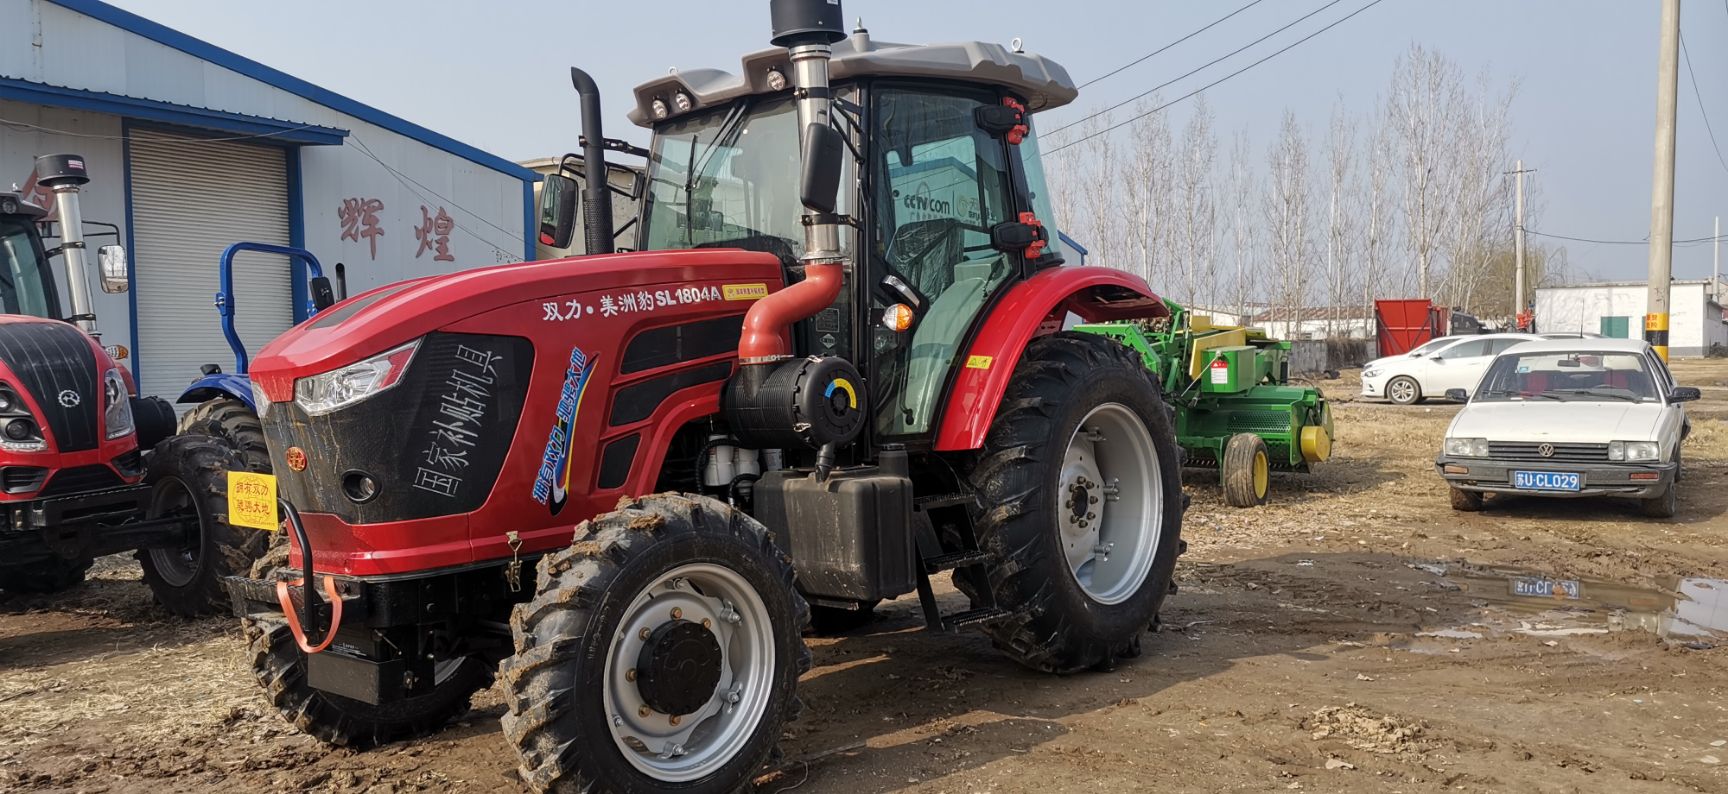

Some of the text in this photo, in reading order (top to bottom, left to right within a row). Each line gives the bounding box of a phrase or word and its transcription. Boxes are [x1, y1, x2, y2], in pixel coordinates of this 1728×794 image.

[338, 198, 455, 261] 辉煌
[412, 344, 503, 498] 国家补贴机具
